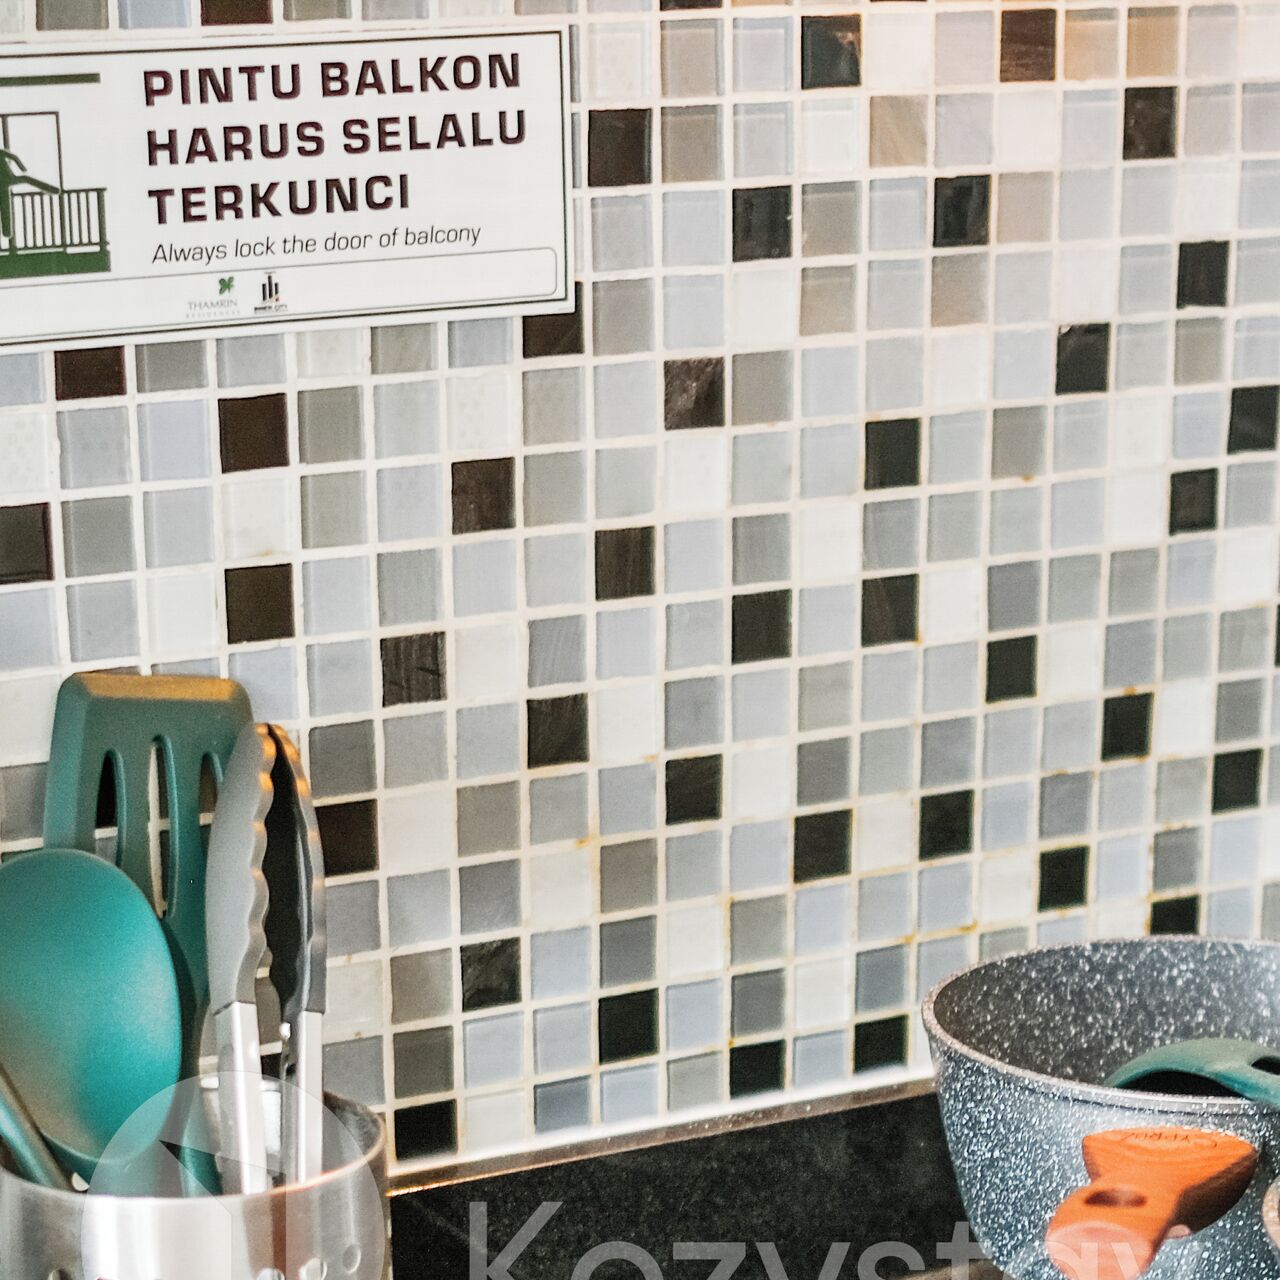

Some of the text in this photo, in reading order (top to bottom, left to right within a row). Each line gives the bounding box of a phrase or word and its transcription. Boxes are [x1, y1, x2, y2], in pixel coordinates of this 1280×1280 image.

[143, 52, 521, 107] PINTU BALKON
[146, 109, 527, 166] HARUS SELALU
[147, 173, 410, 225] TERKUNCI
[151, 224, 482, 266] Always lock the door of balcony
